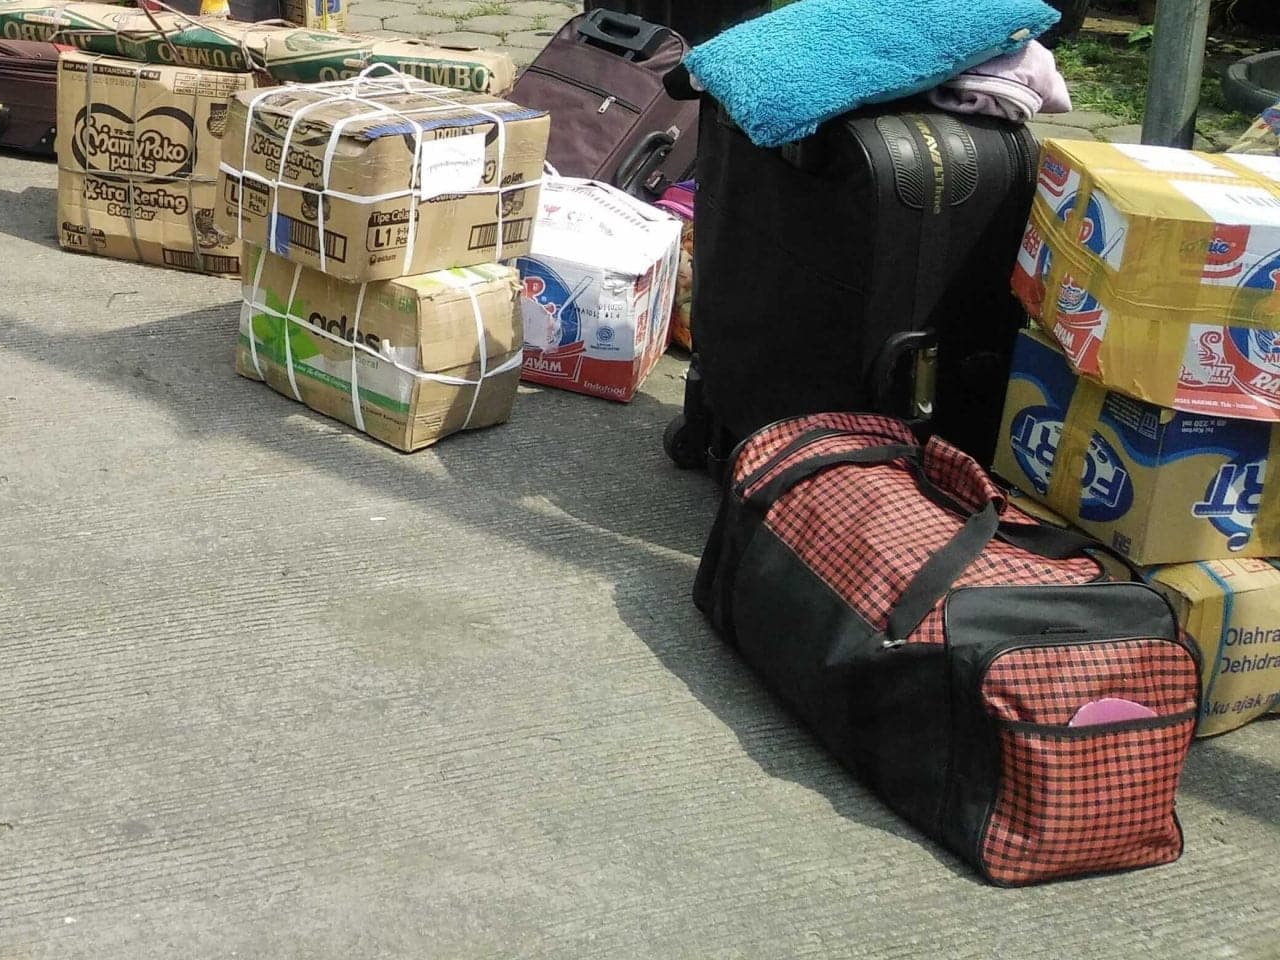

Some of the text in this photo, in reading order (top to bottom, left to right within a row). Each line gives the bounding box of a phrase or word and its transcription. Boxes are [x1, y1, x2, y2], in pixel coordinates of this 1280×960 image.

[79, 114, 189, 165] MamyPoko
[374, 228, 391, 248] L1
[523, 355, 563, 373] AYAM
[583, 379, 627, 396] Indofood
